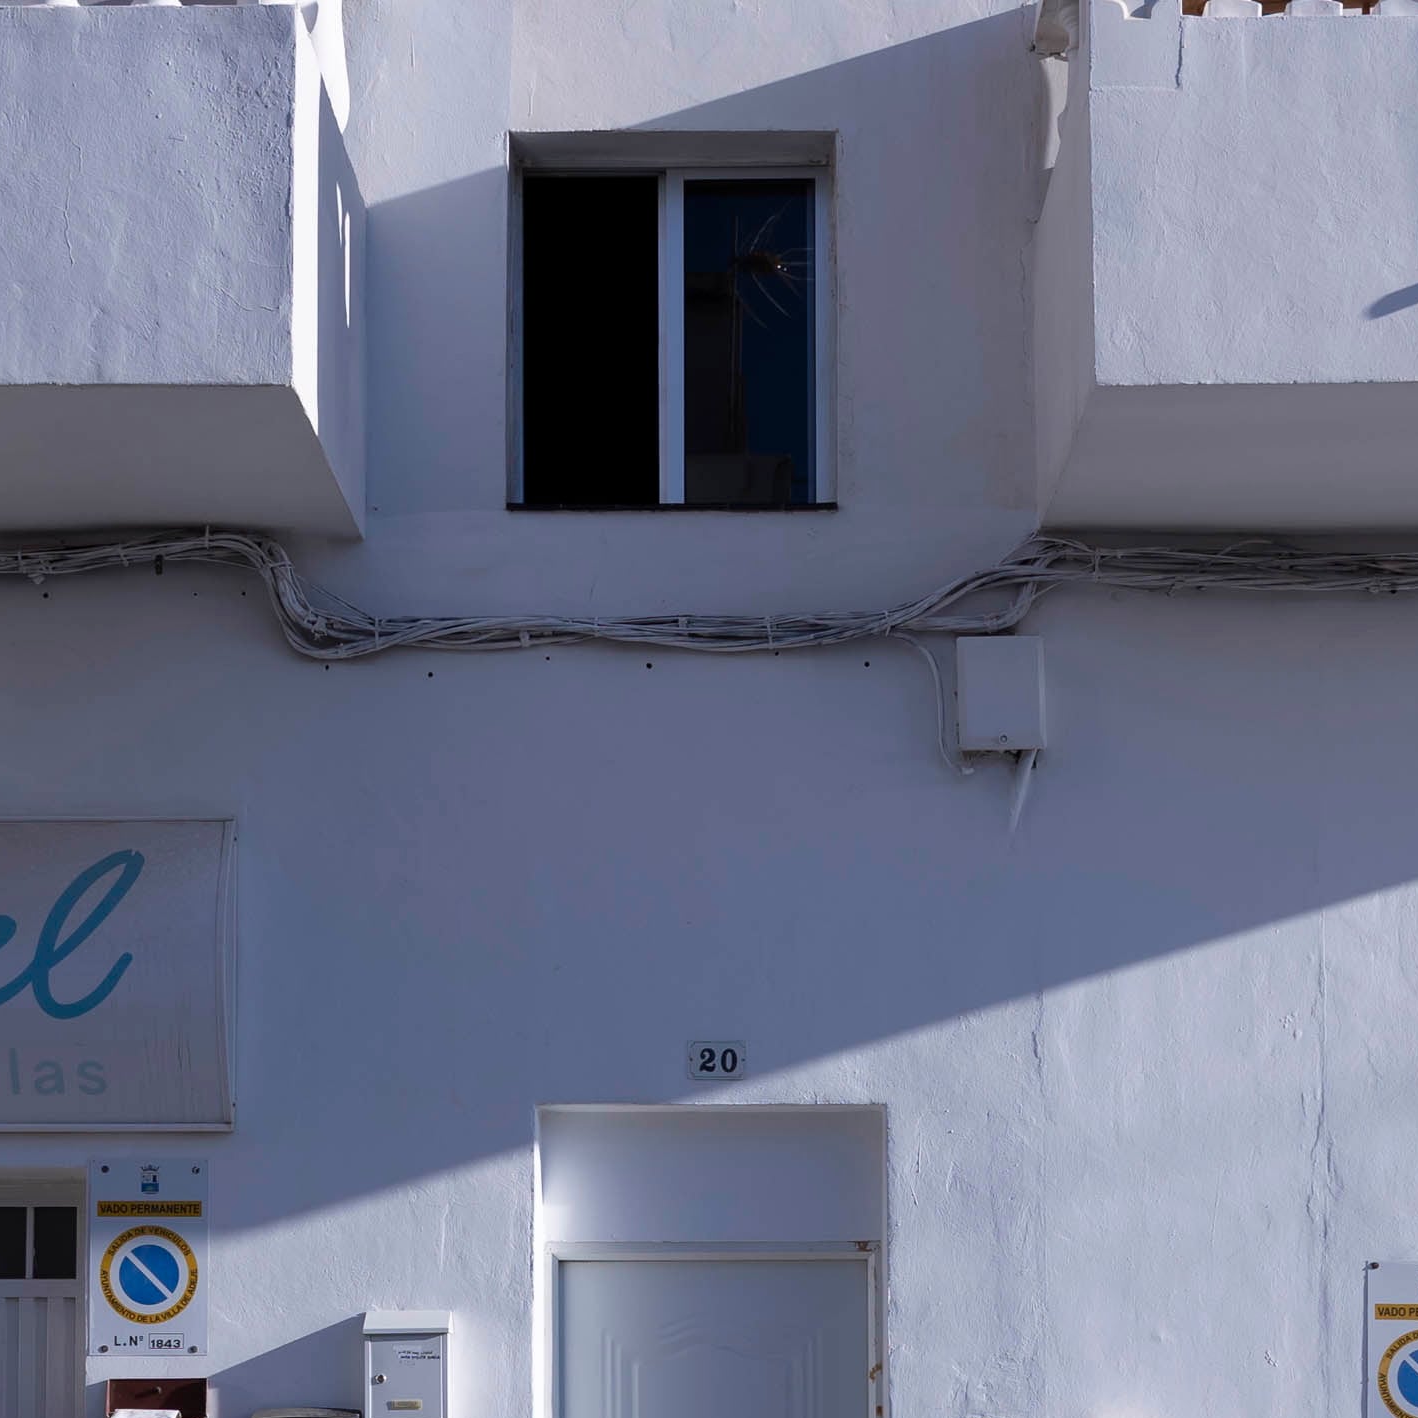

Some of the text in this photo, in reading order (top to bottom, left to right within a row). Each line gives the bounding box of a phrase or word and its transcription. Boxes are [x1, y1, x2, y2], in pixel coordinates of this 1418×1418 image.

[699, 1047, 738, 1073] 20
[99, 1203, 200, 1215] VADO PERMANENTE
[107, 1230, 134, 1257] SALIDA
[134, 1226, 145, 1235] DE
[100, 1269, 136, 1320] AYUNTAMIENTO
[136, 1314, 148, 1323] DE
[149, 1313, 161, 1323] LA
[160, 1304, 184, 1322] VILLA
[187, 1268, 198, 1295] ADEJE
[1377, 1306, 1407, 1317] VADO
[150, 1339, 181, 1348] 1843
[1385, 1335, 1412, 1360] SALIDA
